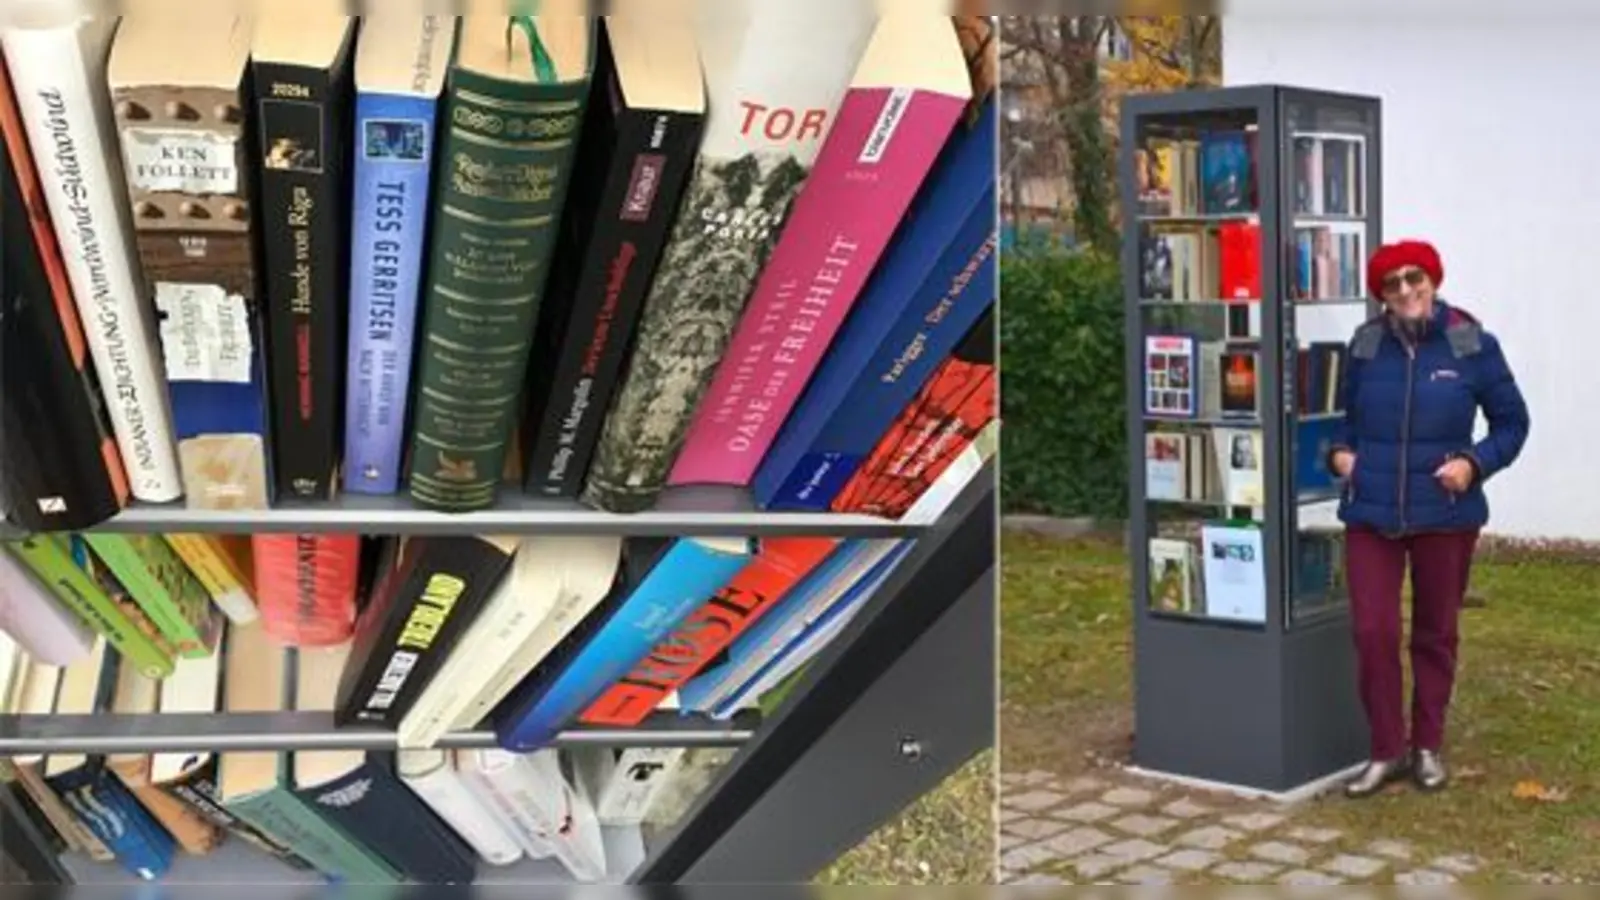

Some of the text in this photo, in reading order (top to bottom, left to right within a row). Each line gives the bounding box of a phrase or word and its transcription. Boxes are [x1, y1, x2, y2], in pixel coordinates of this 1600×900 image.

[741, 102, 827, 141] TOR
[137, 165, 231, 181] FOLLETT
[161, 148, 207, 162] KEN
[288, 186, 310, 226] Riga
[295, 230, 308, 260] von
[368, 182, 404, 340] TESS GERRITSEN
[728, 398, 767, 451] OASE
[776, 236, 858, 364] FREIHEIT
